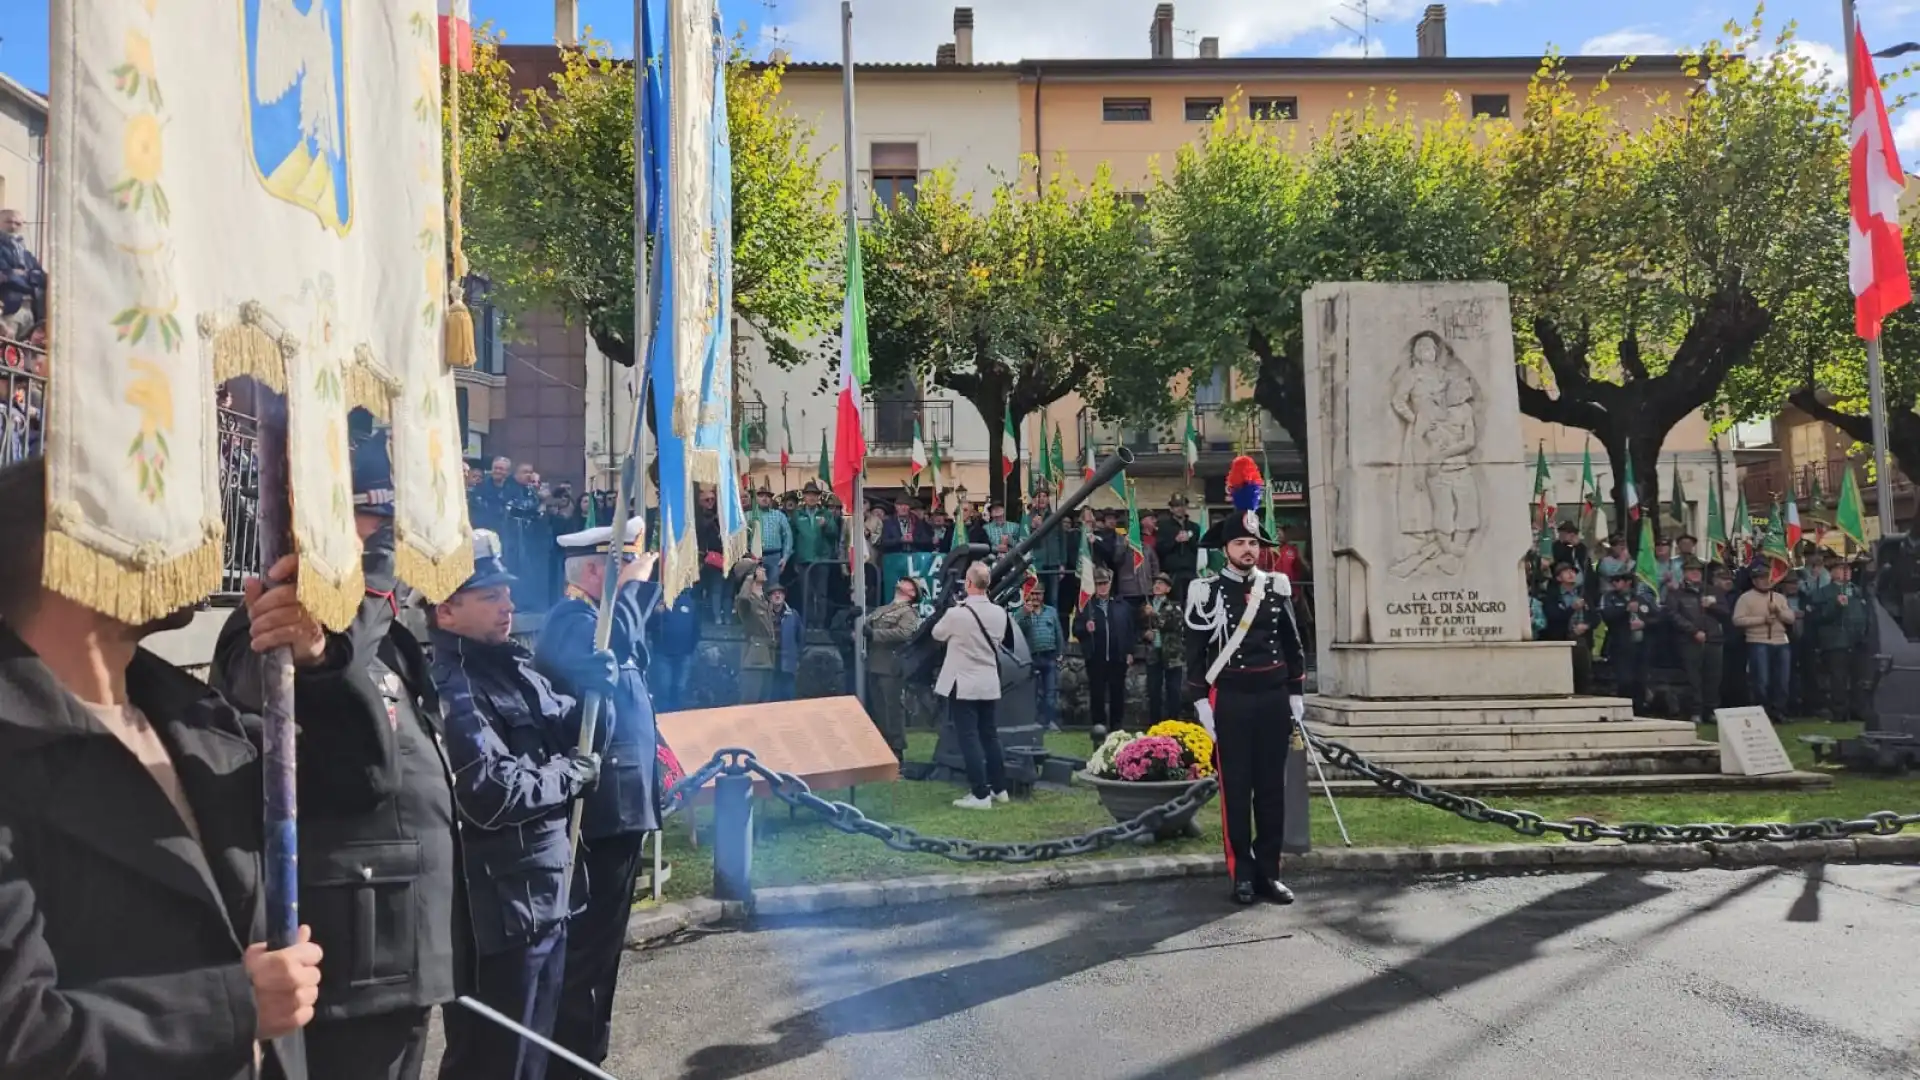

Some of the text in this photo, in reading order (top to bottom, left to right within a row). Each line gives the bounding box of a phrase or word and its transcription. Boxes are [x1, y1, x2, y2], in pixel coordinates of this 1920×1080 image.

[1412, 592, 1428, 601] LA
[1468, 590, 1479, 600] DI
[1386, 601, 1507, 615] CASTEL DI SANGRO
[1420, 615, 1476, 625] AI CADUTI
[1390, 626, 1504, 638] DI TUTTI LE GUERRE
